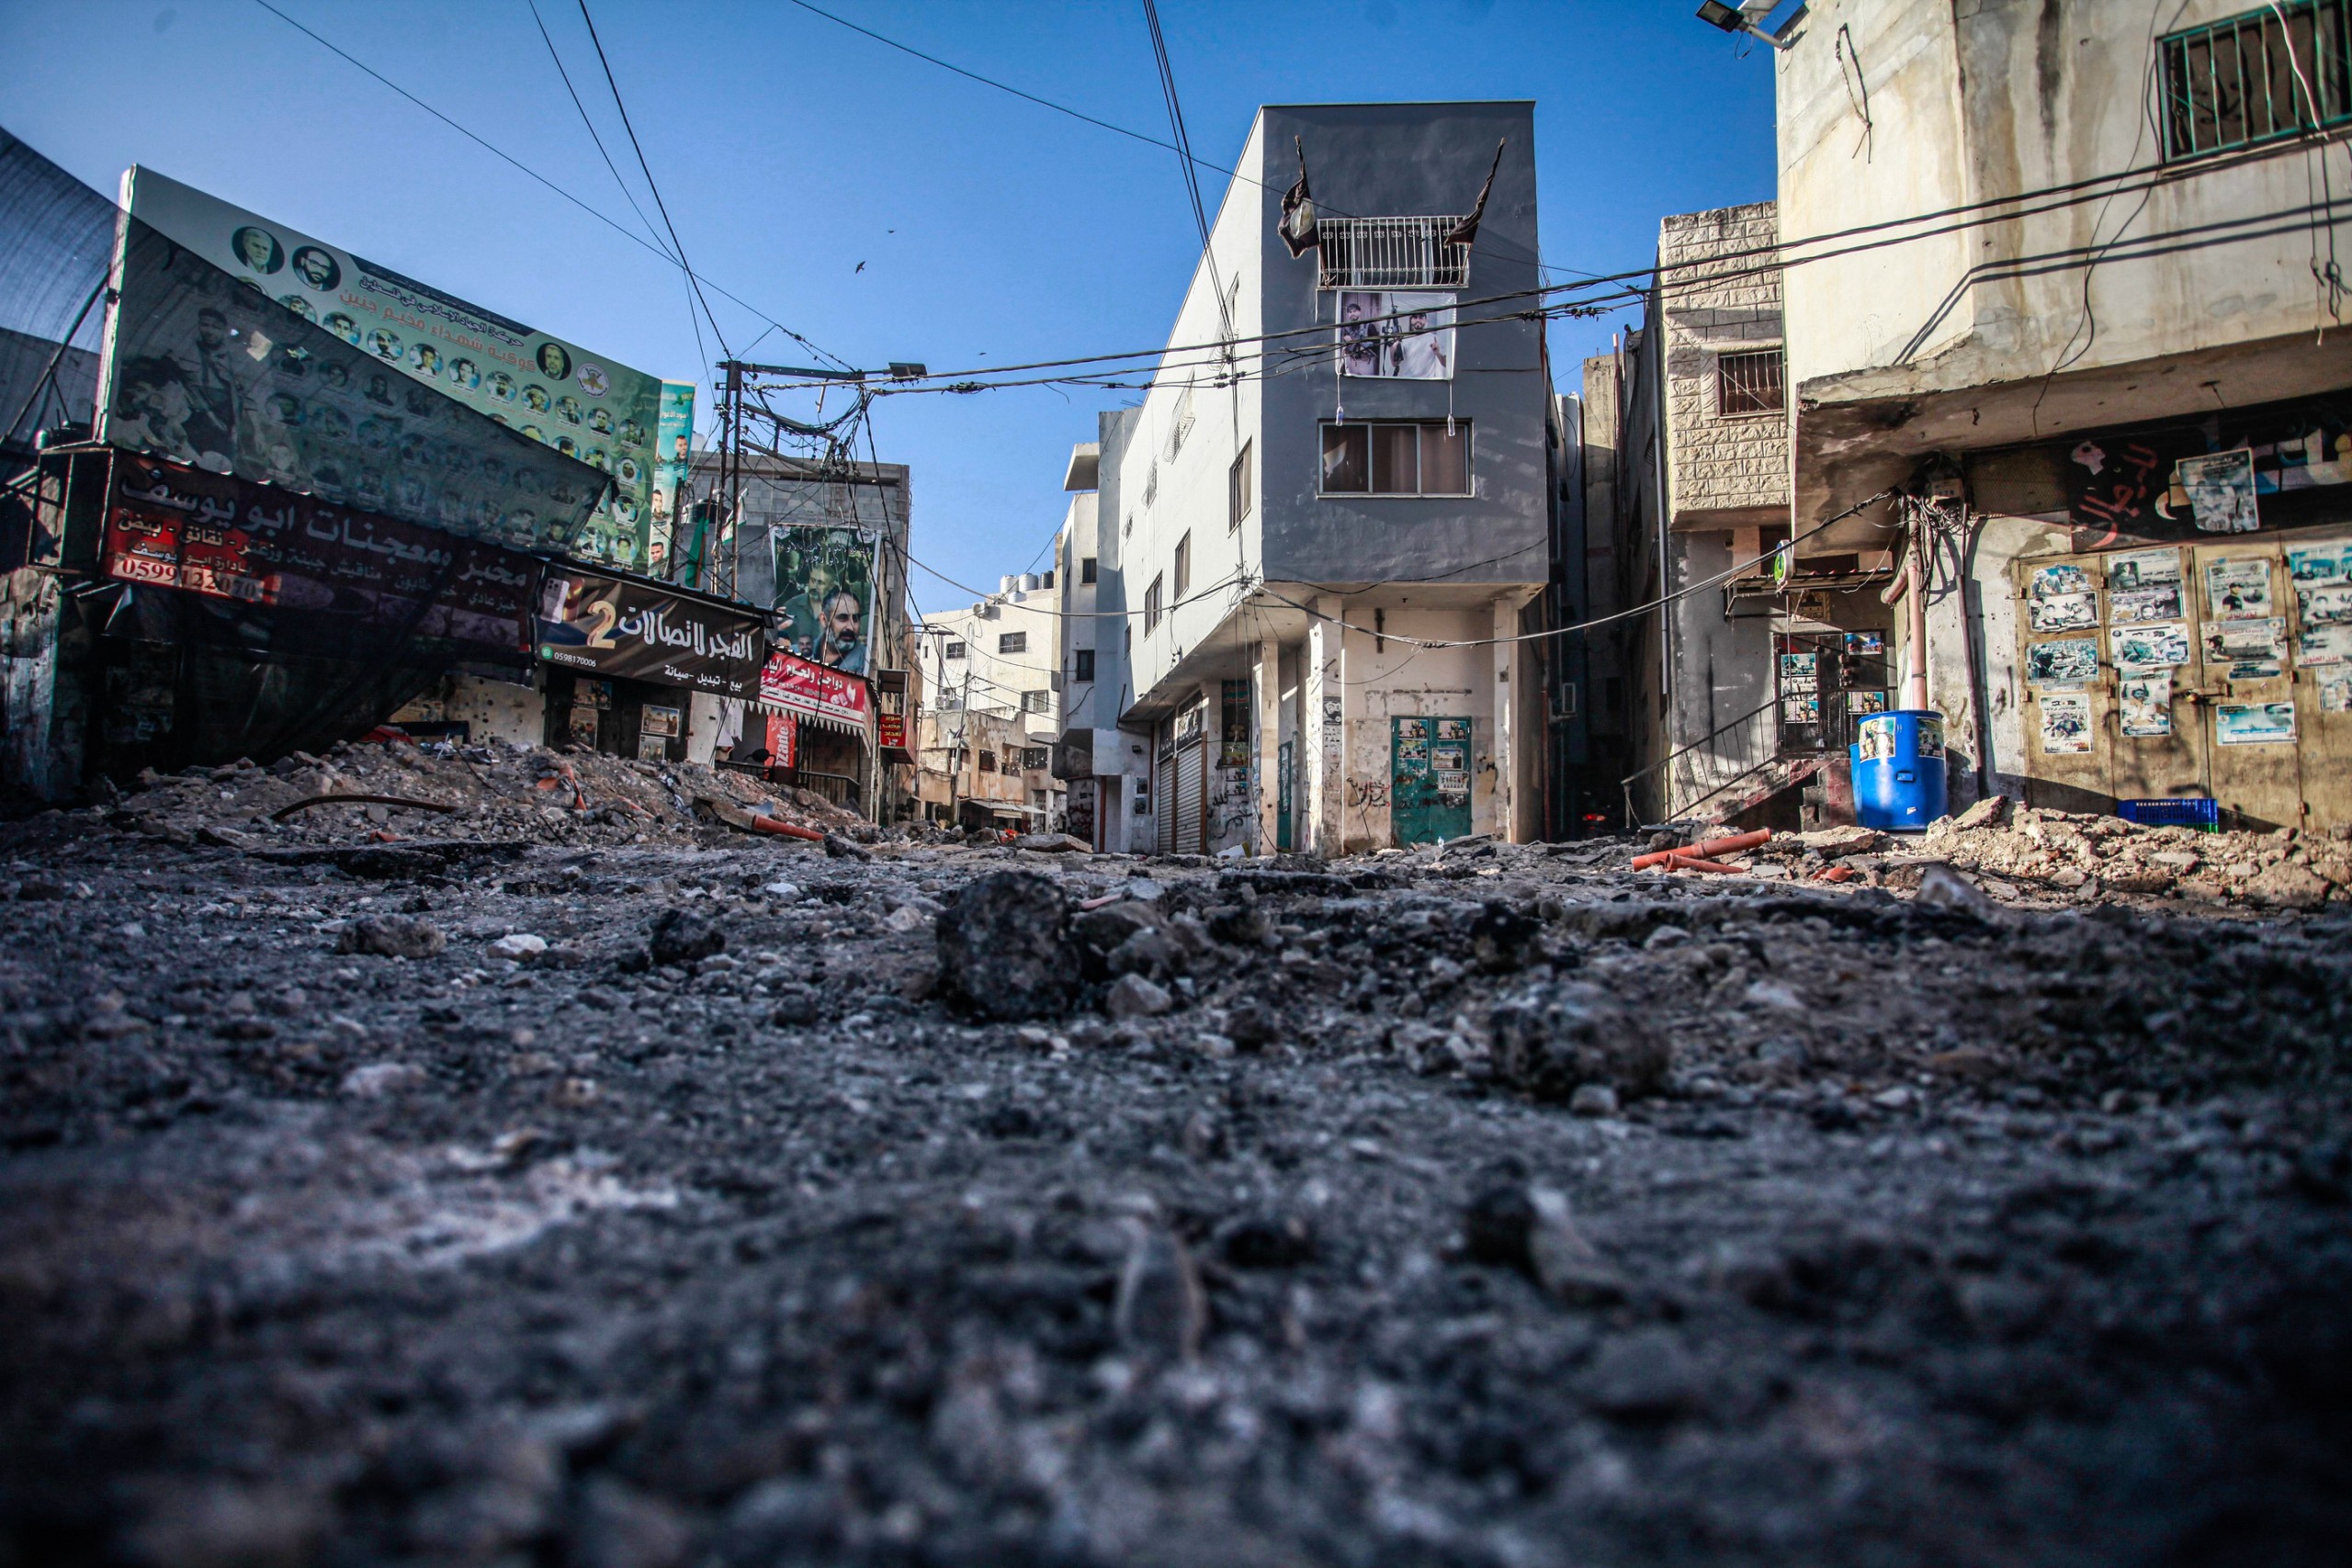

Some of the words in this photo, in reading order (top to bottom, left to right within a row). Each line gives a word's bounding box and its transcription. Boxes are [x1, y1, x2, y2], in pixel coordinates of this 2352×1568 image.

[359, 276, 401, 300] فلسطين
[339, 288, 379, 316] جنين
[382, 304, 426, 332] مخيم
[460, 315, 487, 333] الجهاد
[431, 323, 483, 353] شهداء
[488, 327, 524, 347] حركة
[488, 344, 537, 373] كوكبة
[119, 467, 236, 530] يوسف
[118, 513, 162, 538] بيض
[237, 504, 296, 537] ابو
[179, 525, 223, 547] نقانق
[306, 508, 452, 567] ومعجنات
[130, 541, 178, 564] يوسف
[122, 558, 256, 598] 0599122070
[330, 559, 382, 581] مناقيش
[457, 548, 527, 588] مخبز
[469, 590, 496, 606] عادي
[708, 629, 753, 662] الفجر
[553, 652, 597, 669] 0598170006
[696, 672, 721, 686] تبديل
[786, 663, 816, 683] ولحوم
[817, 671, 843, 691] دواجن
[729, 679, 743, 692] بيع
